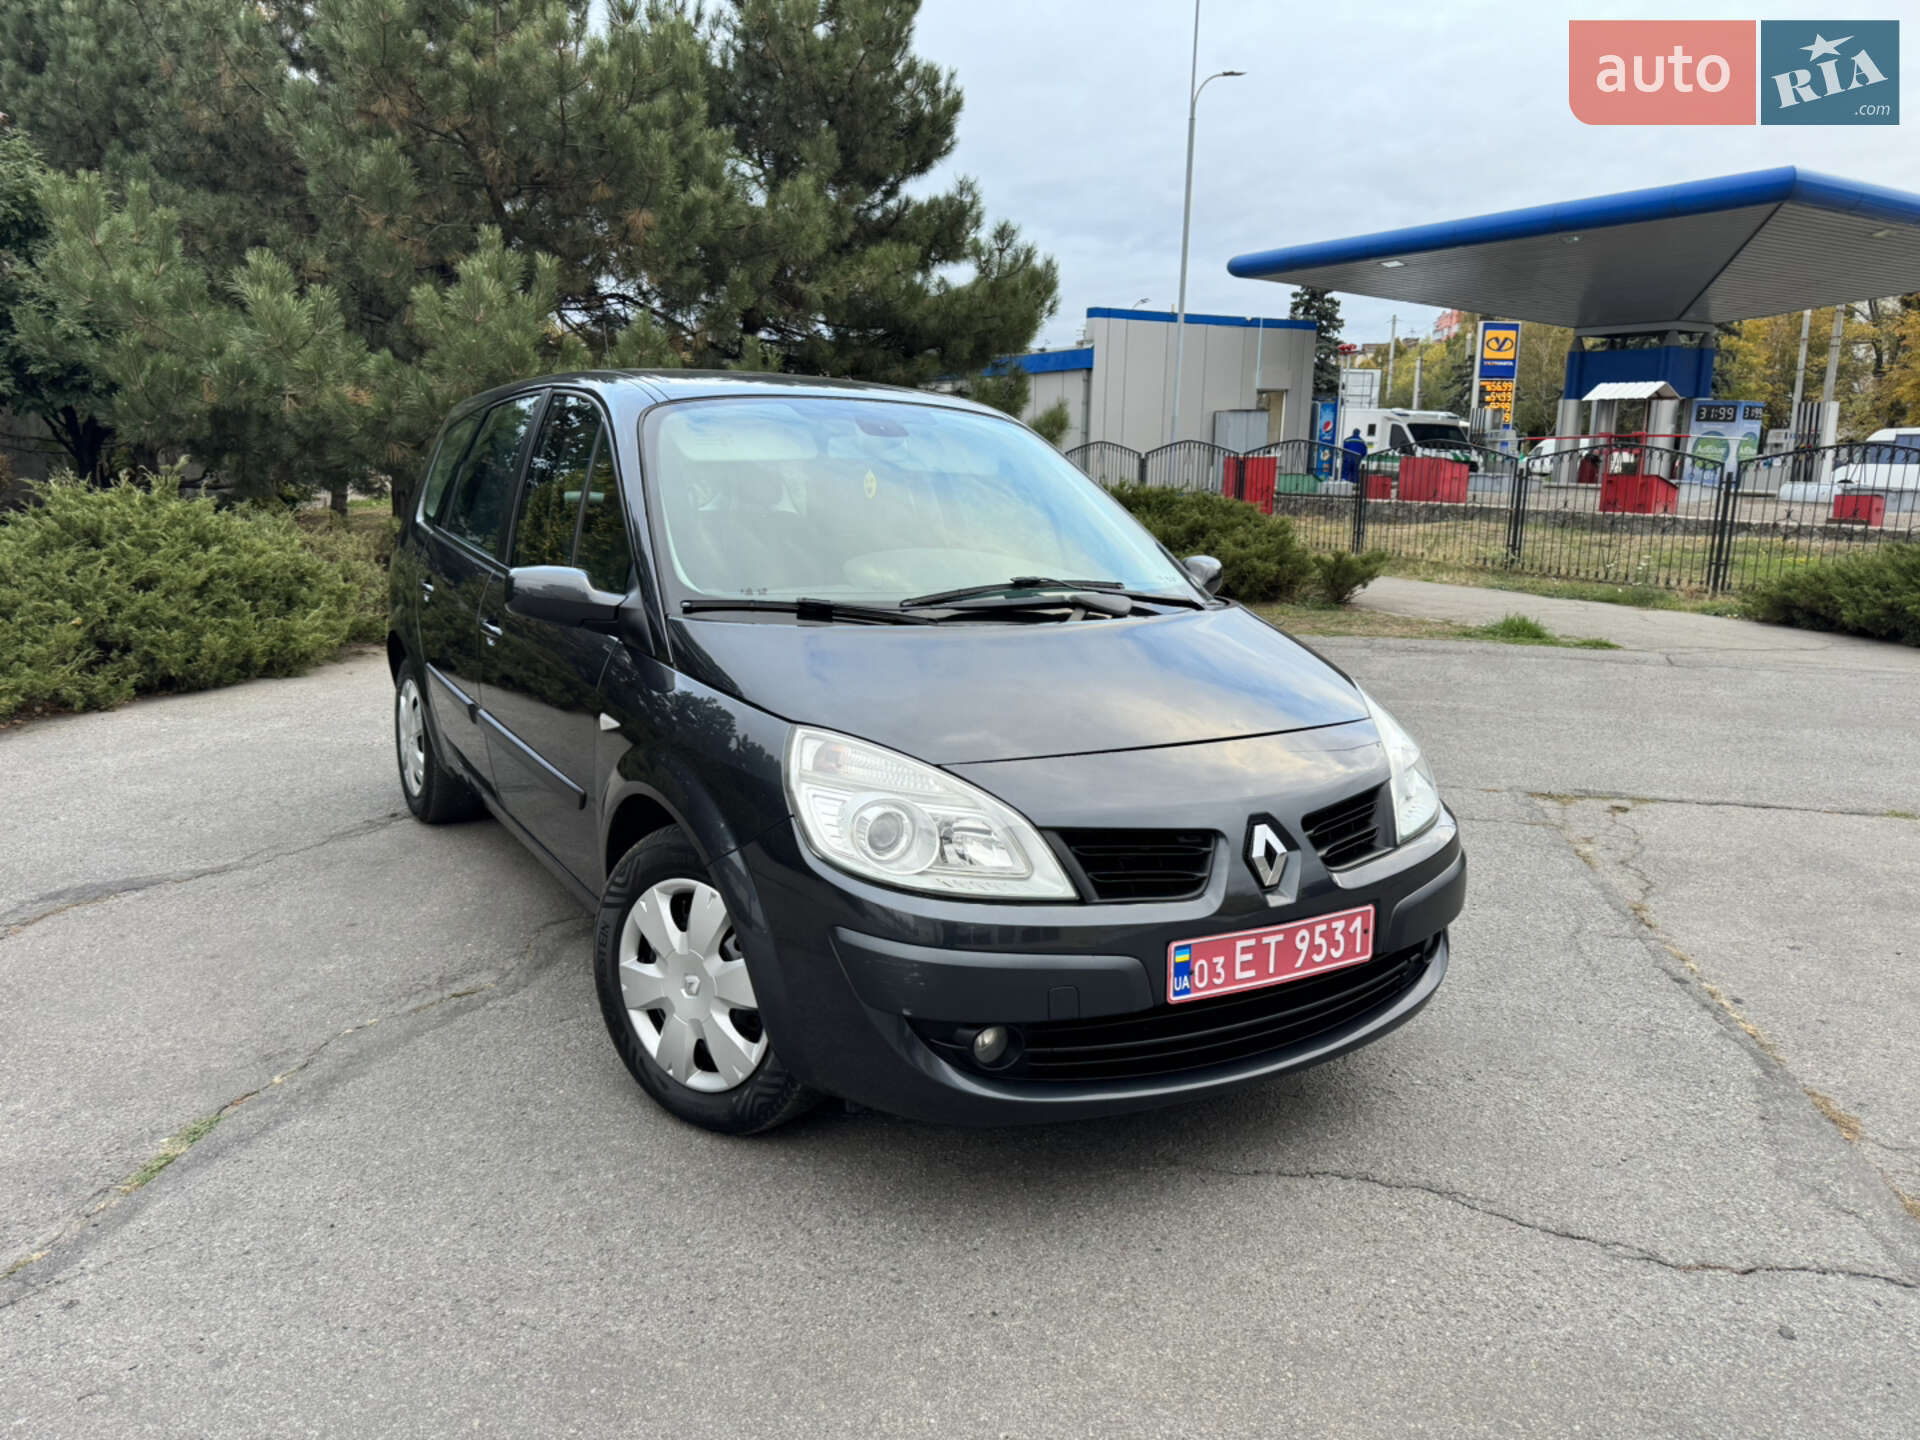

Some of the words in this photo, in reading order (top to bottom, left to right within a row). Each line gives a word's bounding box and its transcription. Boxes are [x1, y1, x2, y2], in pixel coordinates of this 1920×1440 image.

[1194, 956, 1225, 989] 03
[1235, 934, 1285, 980] ET
[1294, 916, 1363, 968] 9531
[1174, 975, 1191, 991] UA
